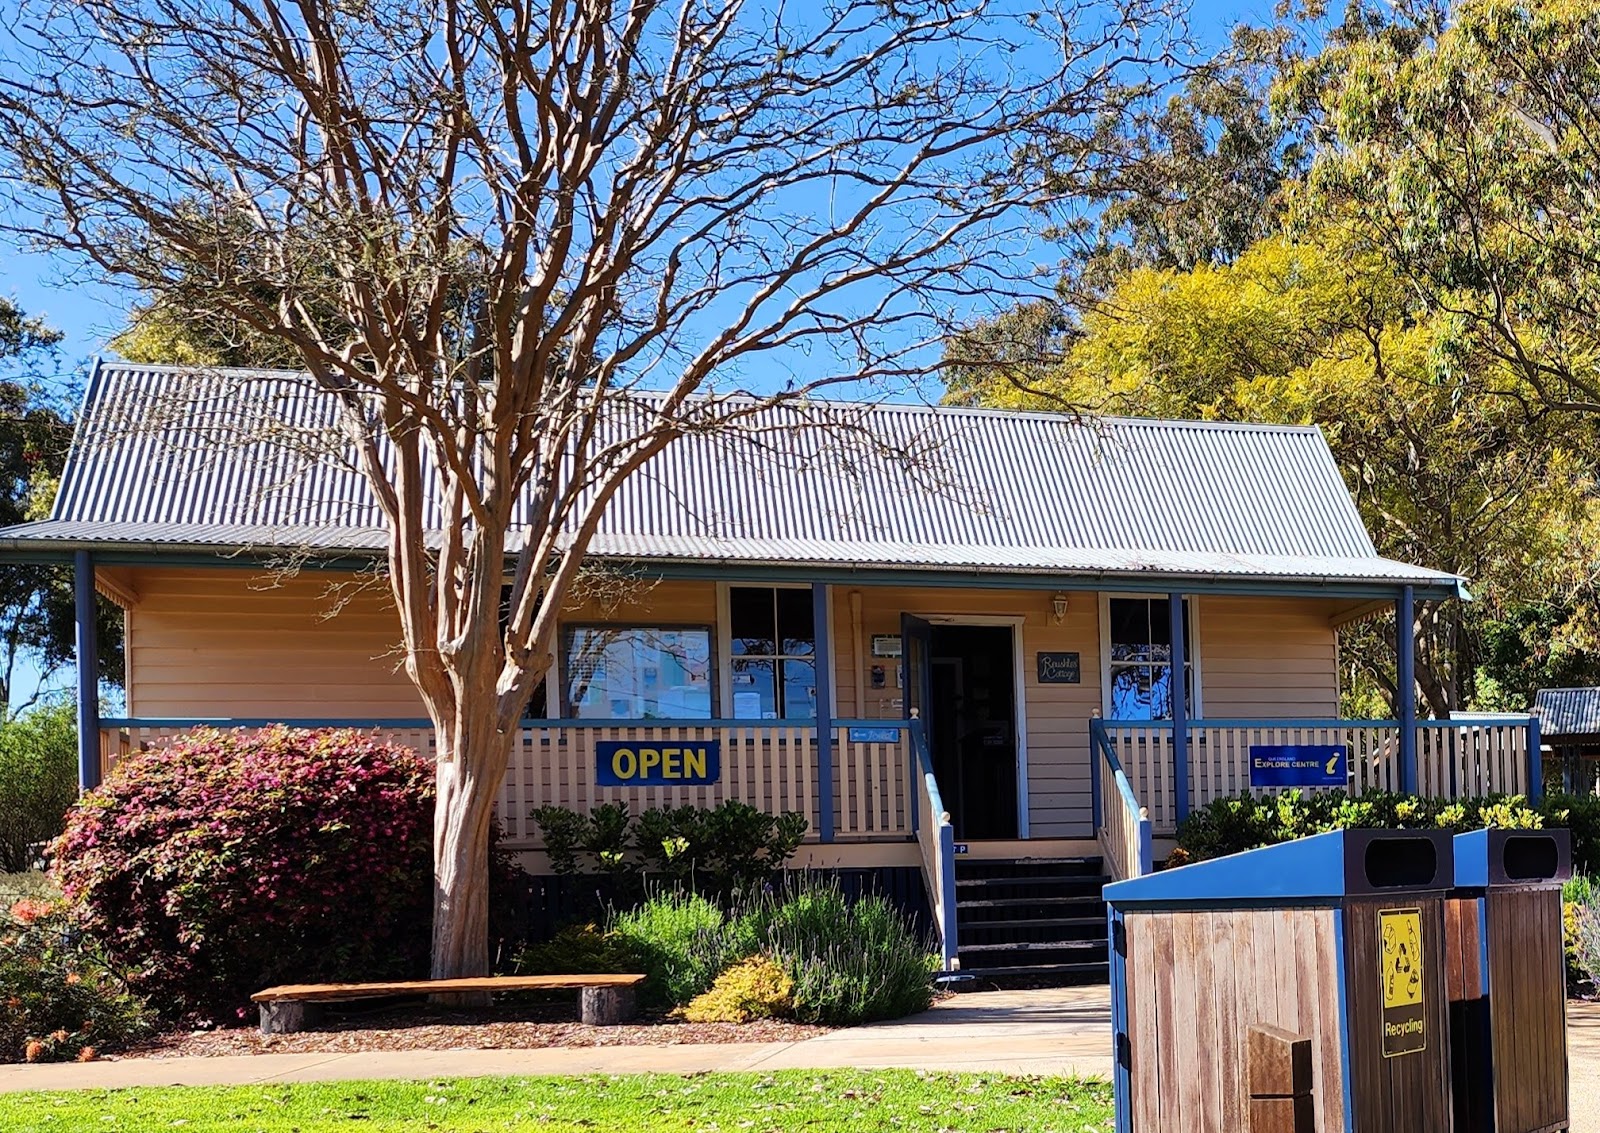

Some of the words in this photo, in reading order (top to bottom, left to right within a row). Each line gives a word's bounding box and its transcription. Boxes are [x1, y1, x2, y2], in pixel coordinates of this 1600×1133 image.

[612, 748, 706, 779] OPEN
[1254, 758, 1290, 768] EXPLORE
[1385, 1018, 1423, 1037] Recycling
